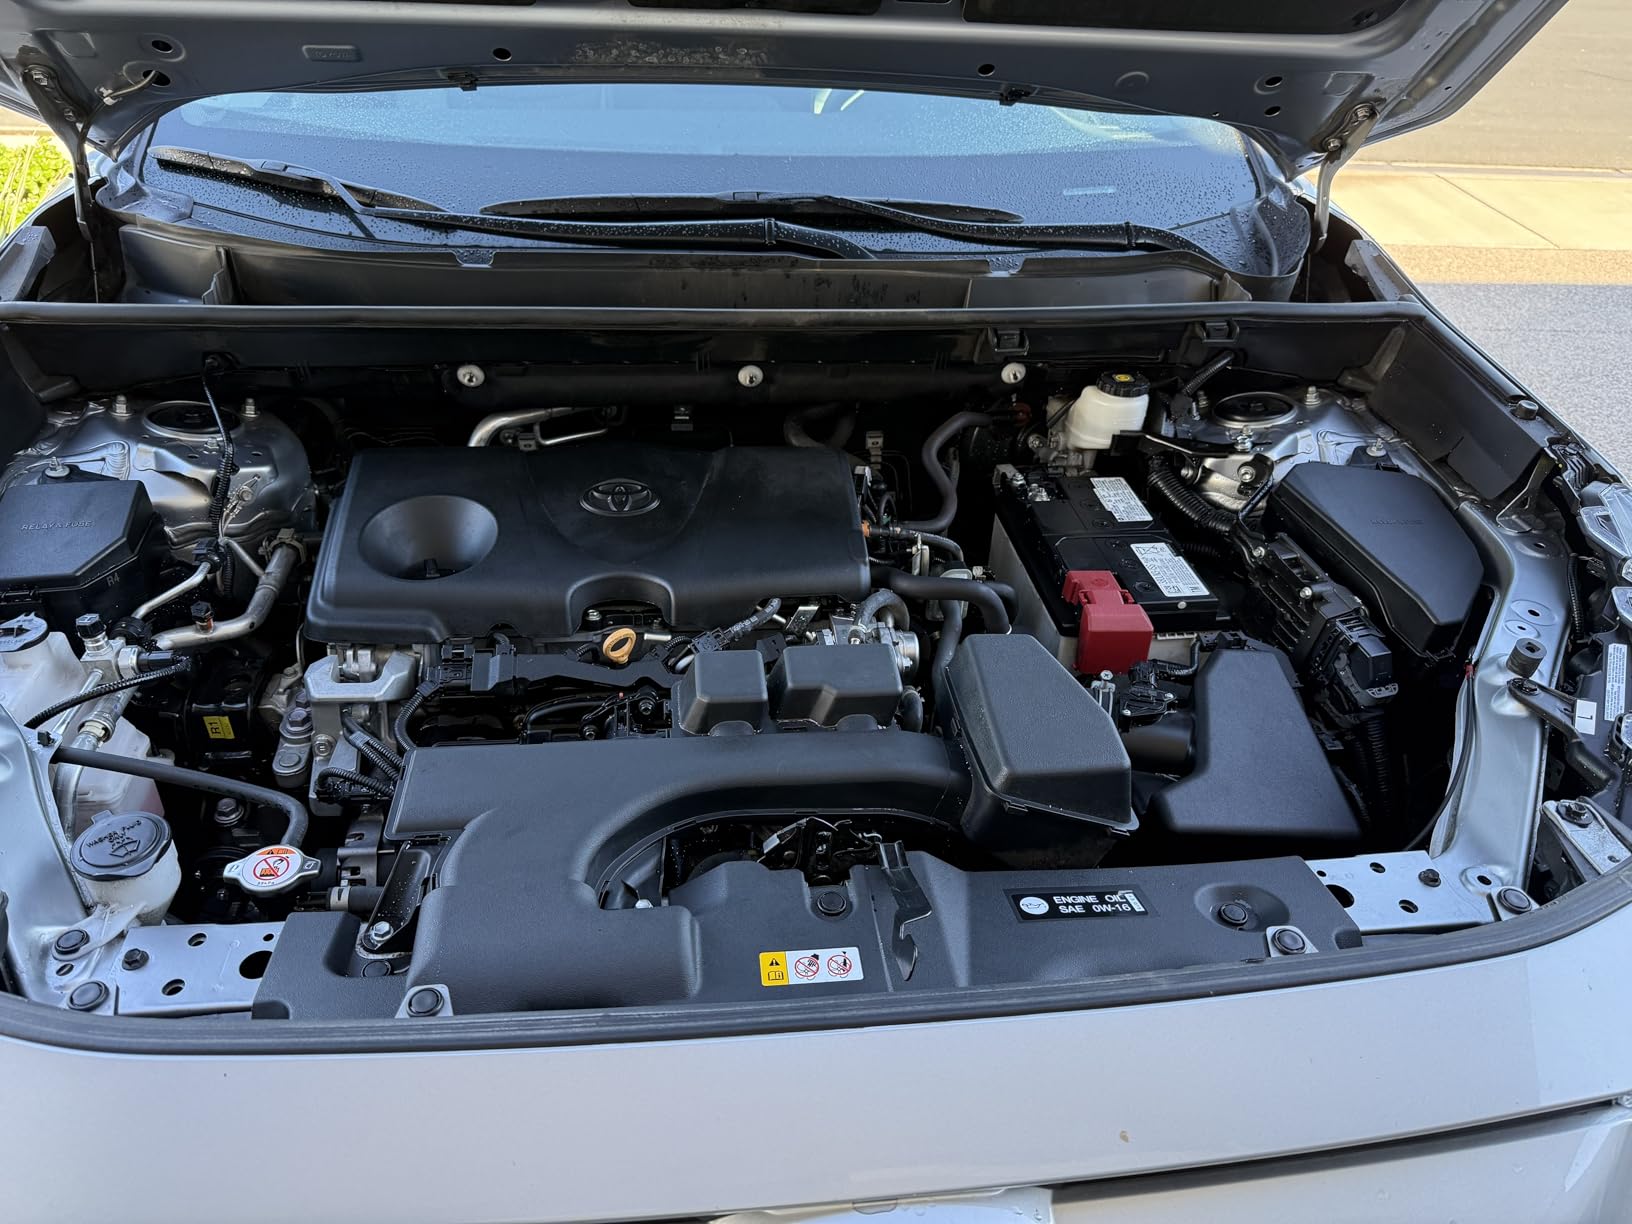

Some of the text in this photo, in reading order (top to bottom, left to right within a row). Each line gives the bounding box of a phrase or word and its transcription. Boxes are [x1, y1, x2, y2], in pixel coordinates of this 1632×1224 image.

[106, 572, 120, 587] R4
[208, 721, 221, 735] R1
[1053, 895, 1099, 905] ENGINE
[1104, 893, 1127, 903] OIL
[1059, 903, 1131, 914] SAE 0W-16
